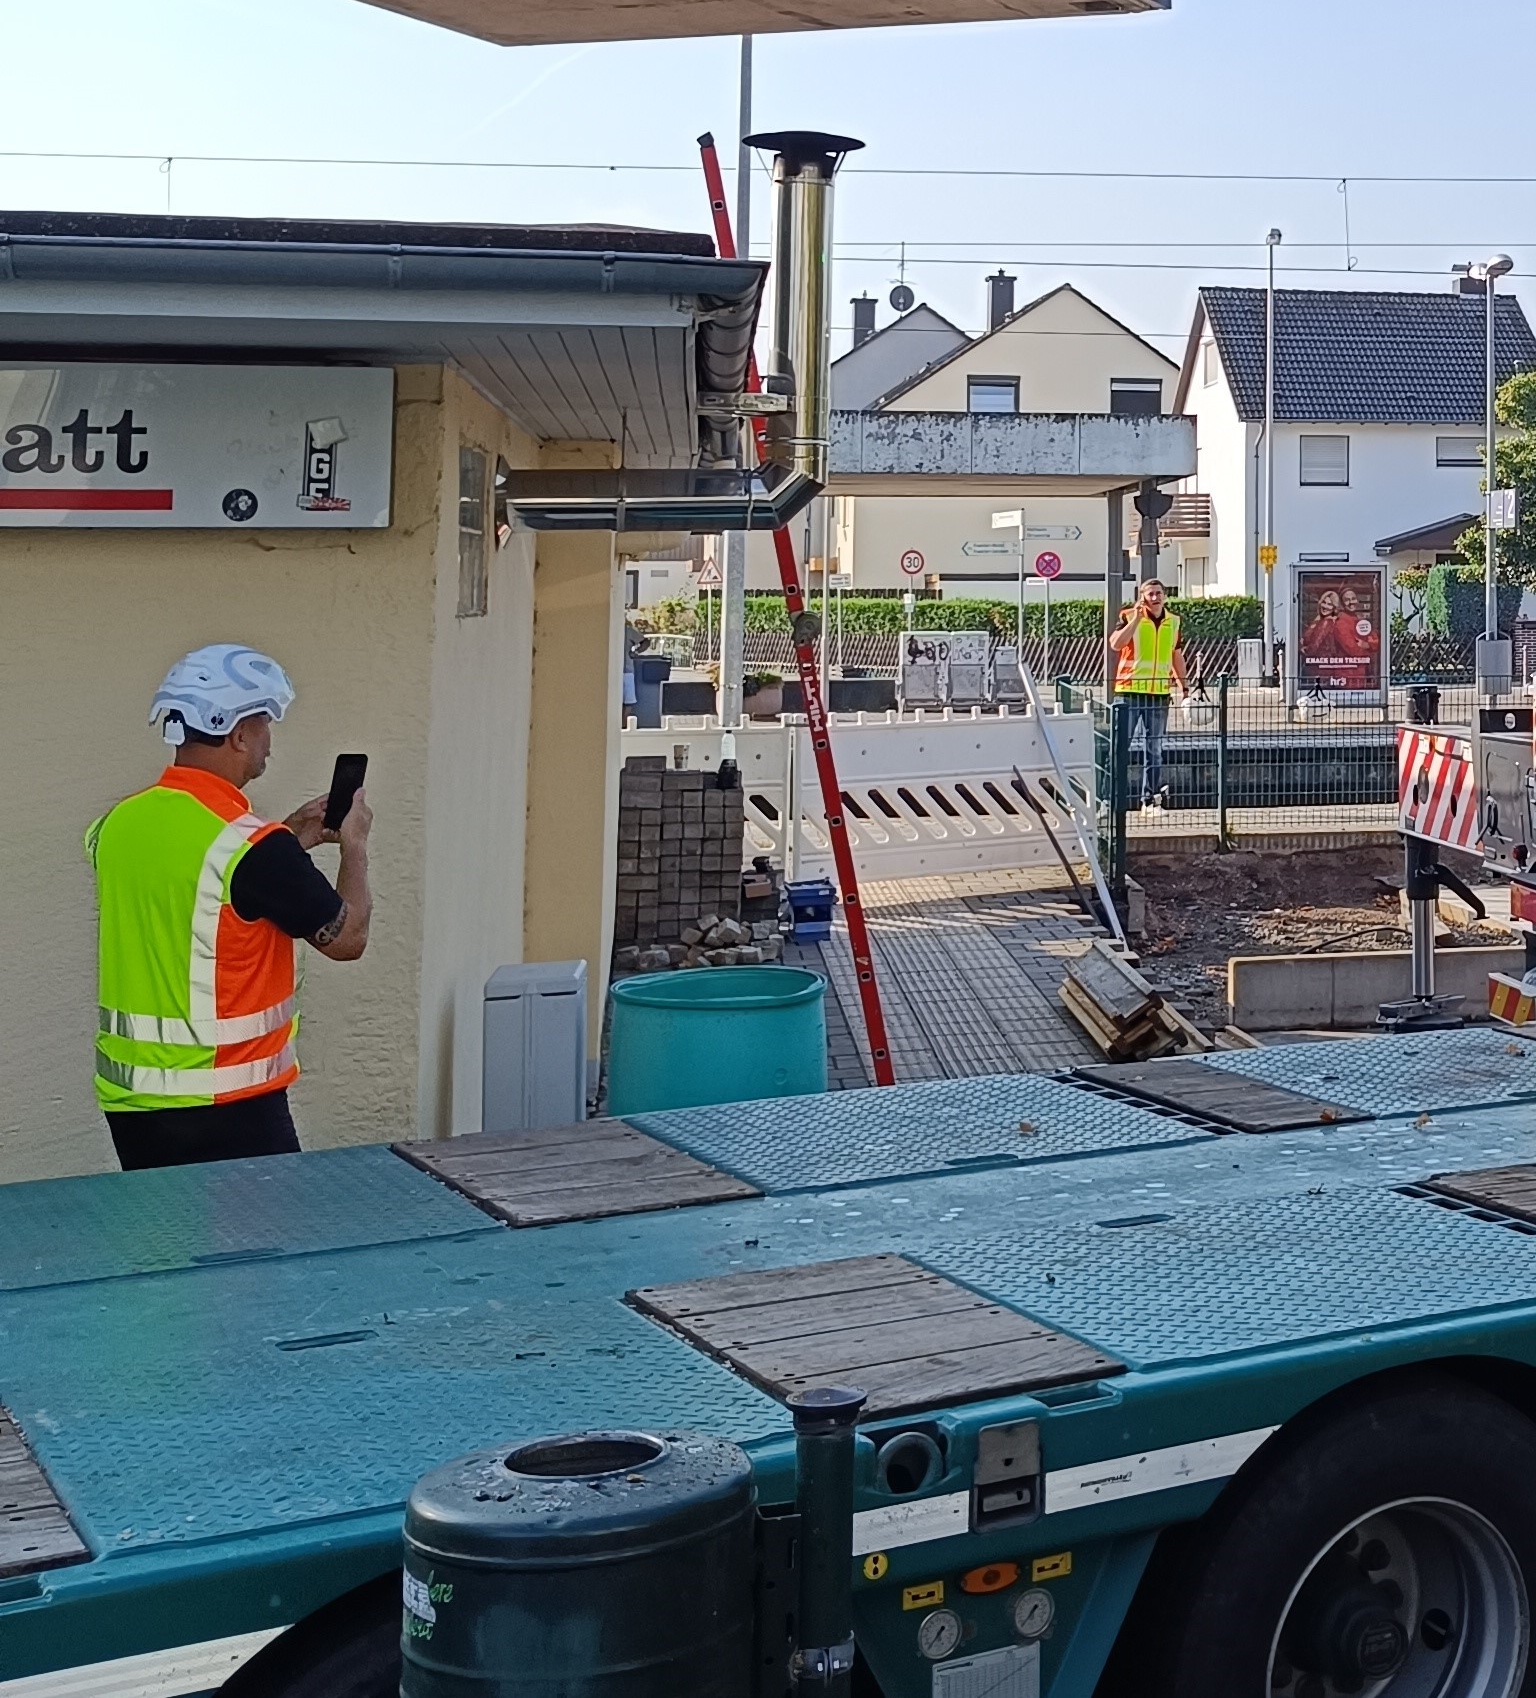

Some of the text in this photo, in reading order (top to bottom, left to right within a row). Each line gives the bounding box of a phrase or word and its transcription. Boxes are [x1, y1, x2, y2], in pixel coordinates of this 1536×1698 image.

[2, 408, 149, 474] att
[905, 556, 920, 569] 30
[1329, 676, 1347, 687] hr3
